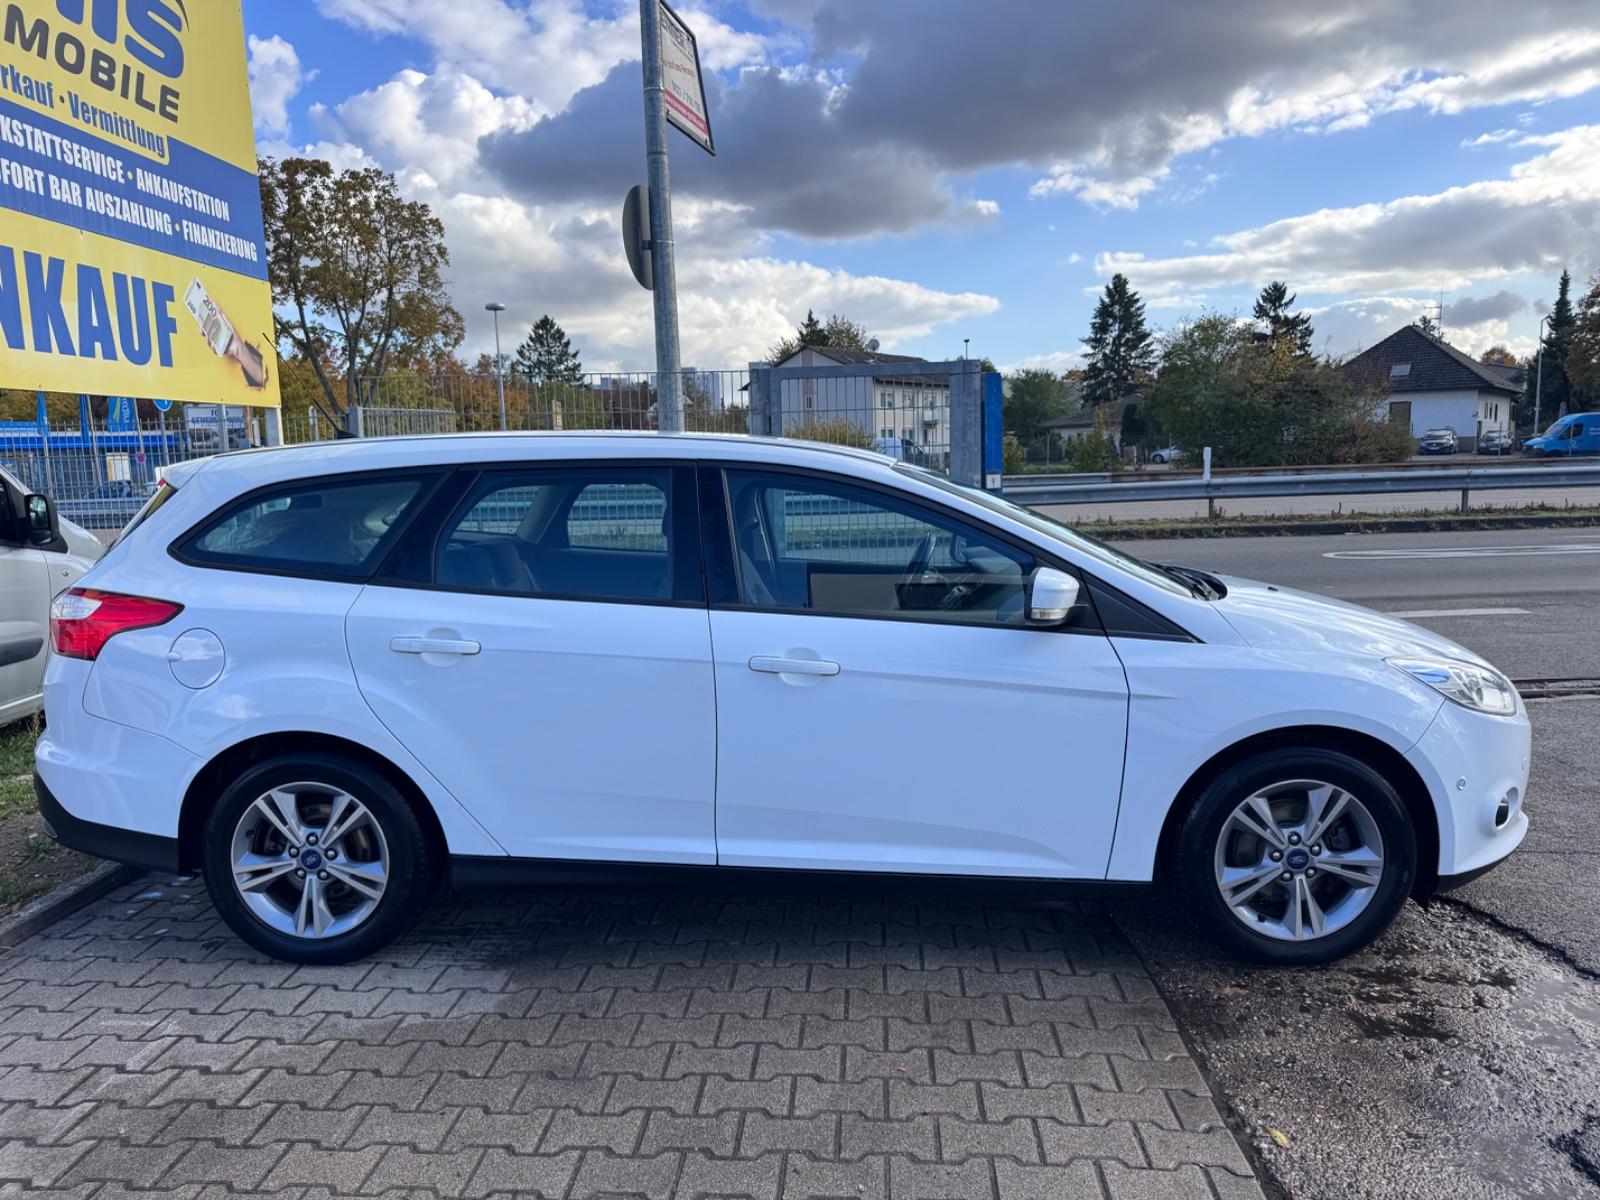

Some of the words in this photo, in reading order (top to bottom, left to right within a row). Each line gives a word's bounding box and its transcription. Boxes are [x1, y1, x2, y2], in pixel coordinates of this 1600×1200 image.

[4, 3, 180, 124] MOBILE
[0, 64, 55, 110] rkauf
[67, 90, 165, 159] Vermittlung
[48, 174, 83, 208] BAR
[85, 186, 173, 236] AUSZAHLUNG
[182, 219, 258, 262] FINANZIERUNG
[136, 168, 230, 221] ANKAUFSTATION
